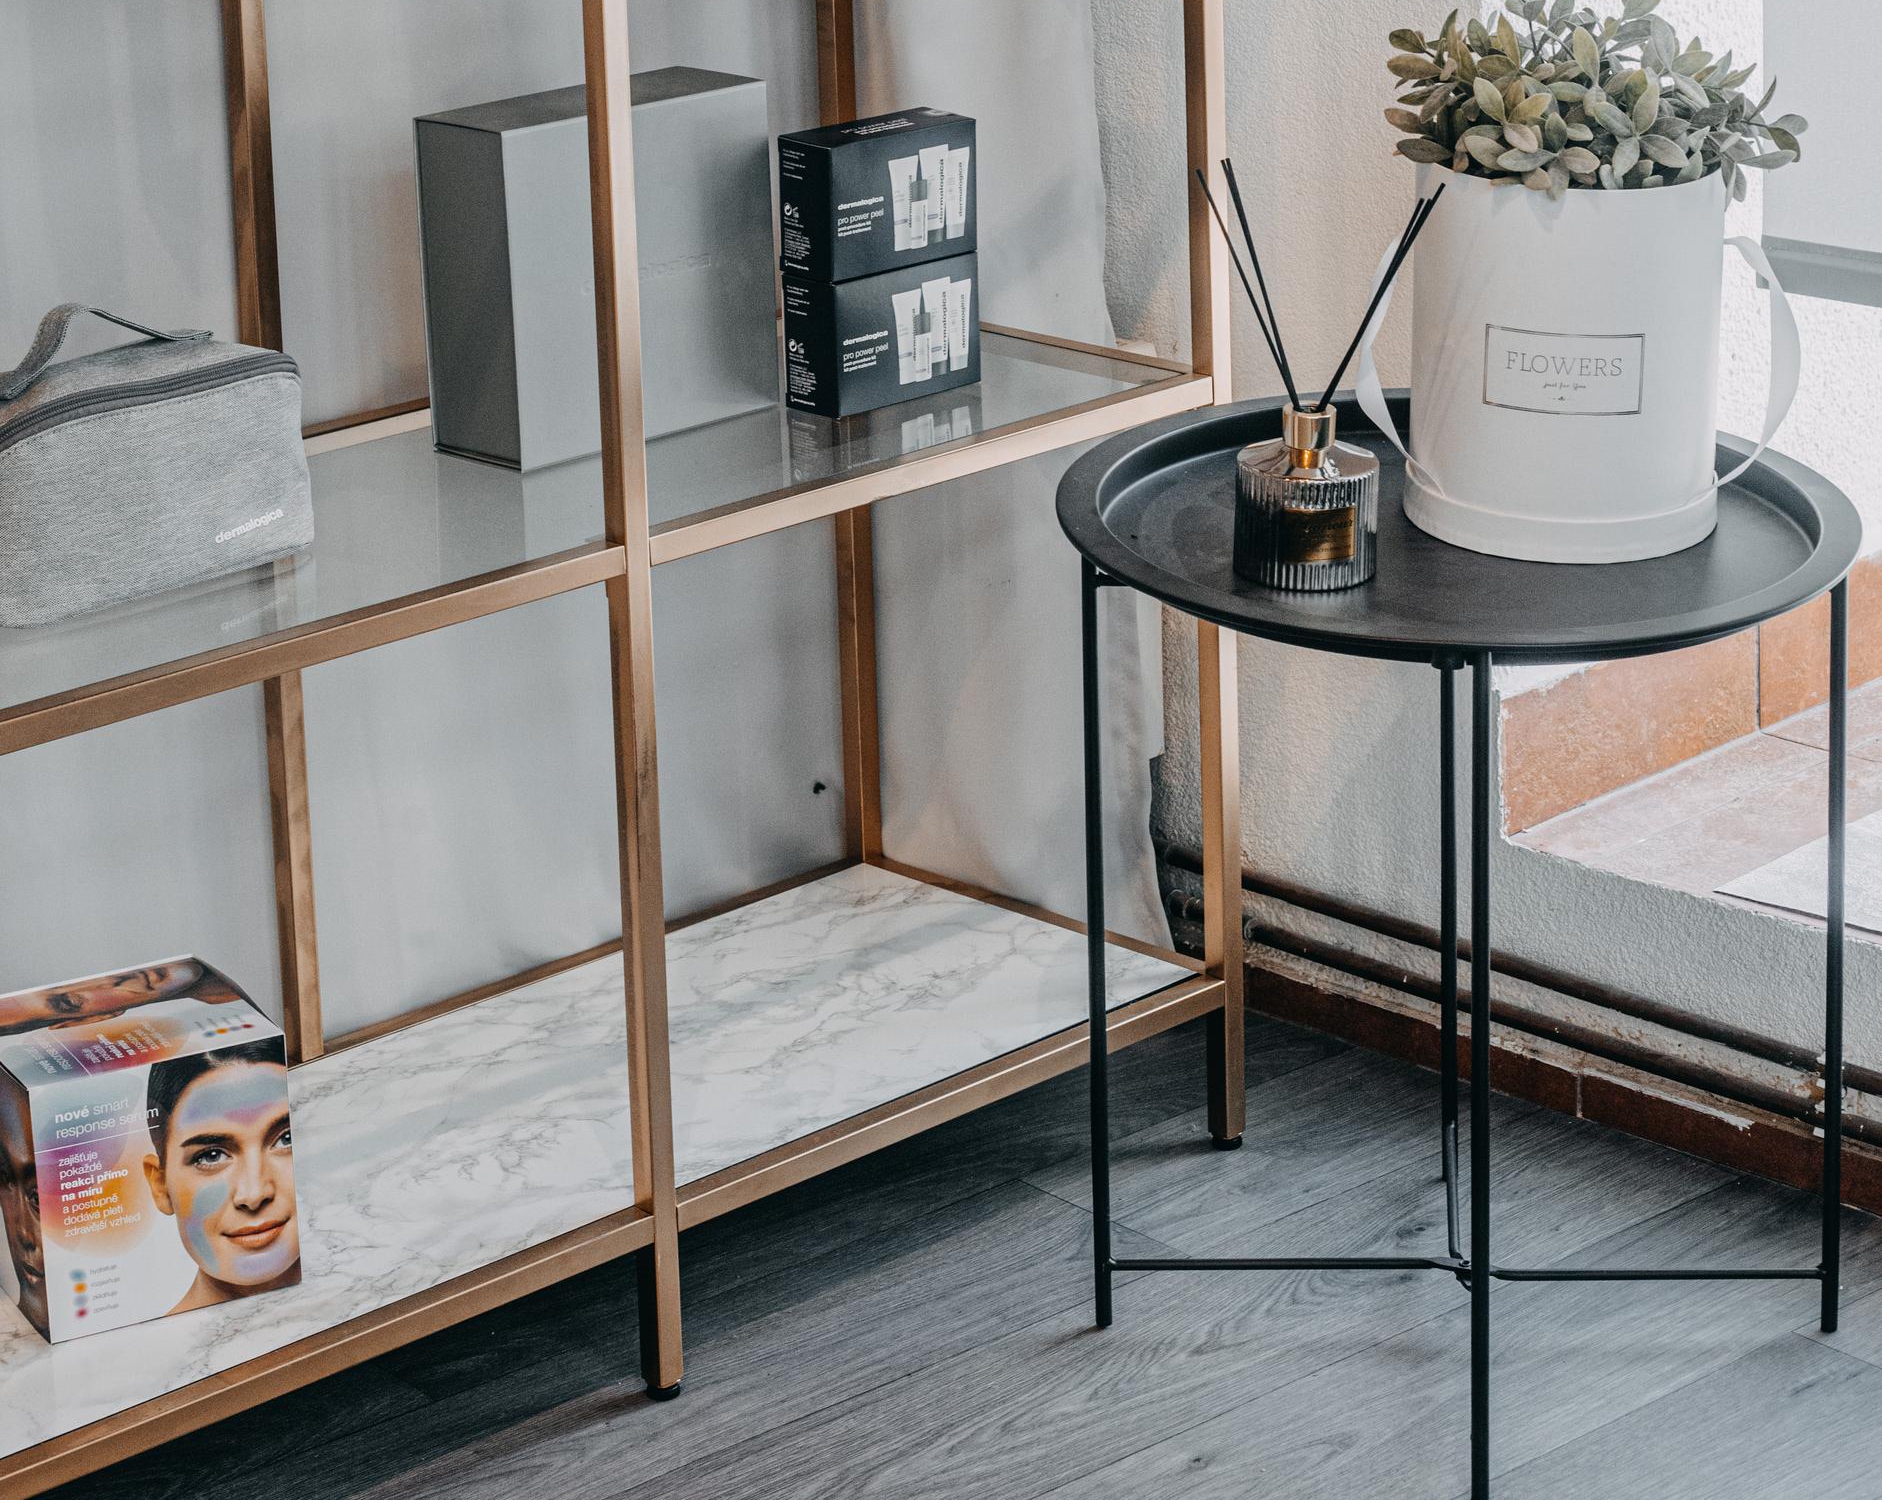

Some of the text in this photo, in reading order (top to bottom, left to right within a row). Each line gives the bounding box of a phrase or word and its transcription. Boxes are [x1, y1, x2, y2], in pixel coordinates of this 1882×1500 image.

[837, 196, 885, 211] dermalogica
[837, 208, 885, 226] pro power peel
[842, 330, 889, 346] dermalogica
[843, 342, 889, 362] pro power peel
[1505, 350, 1623, 377] FLOWERS
[215, 508, 284, 544] dermalogica
[55, 1098, 129, 1124] nové smart
[56, 1107, 159, 1139] response serum
[58, 1150, 98, 1167] zajišťuje
[59, 1162, 102, 1181] pokaždé
[60, 1167, 129, 1190] reakci přímo
[61, 1185, 104, 1203] na míru
[62, 1194, 119, 1214] a postupně
